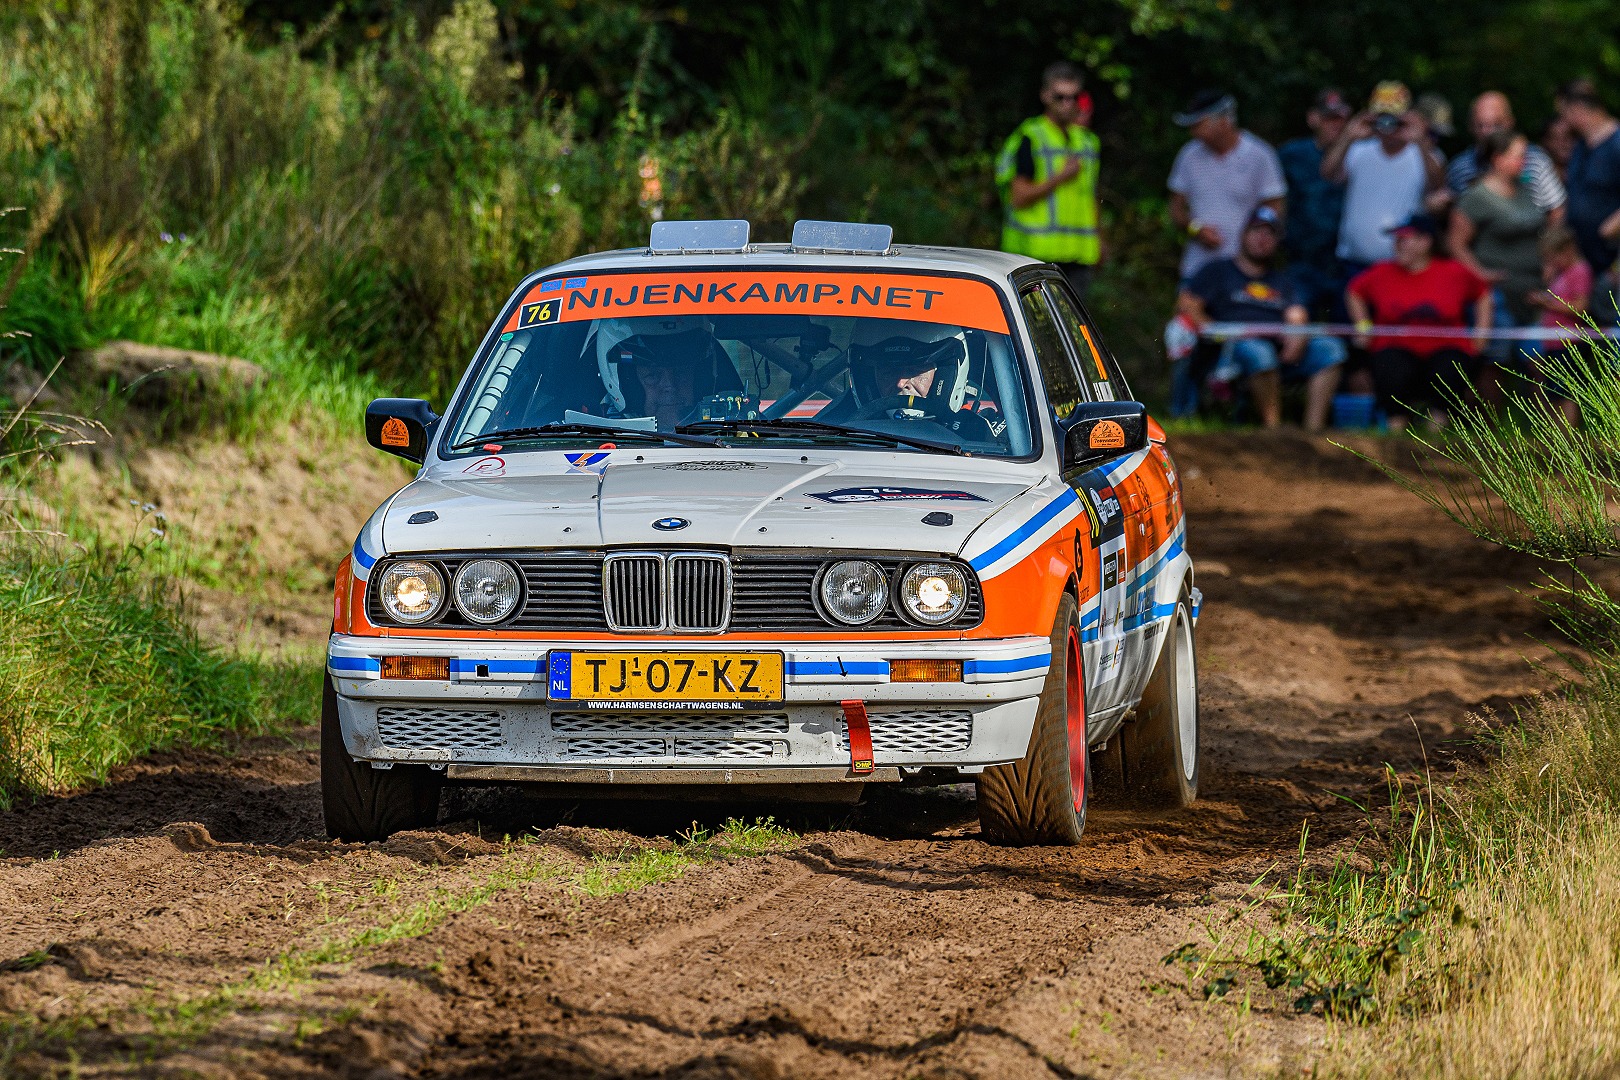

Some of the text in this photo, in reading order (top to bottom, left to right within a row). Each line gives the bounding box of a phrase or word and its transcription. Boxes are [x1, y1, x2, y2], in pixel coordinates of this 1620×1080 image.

[567, 282, 944, 311] NIJENKAMP.NET
[528, 303, 551, 324] 76
[552, 679, 568, 691] NL
[587, 701, 744, 711] WWW.HARMSENSCHAFTWAGENS.NL
